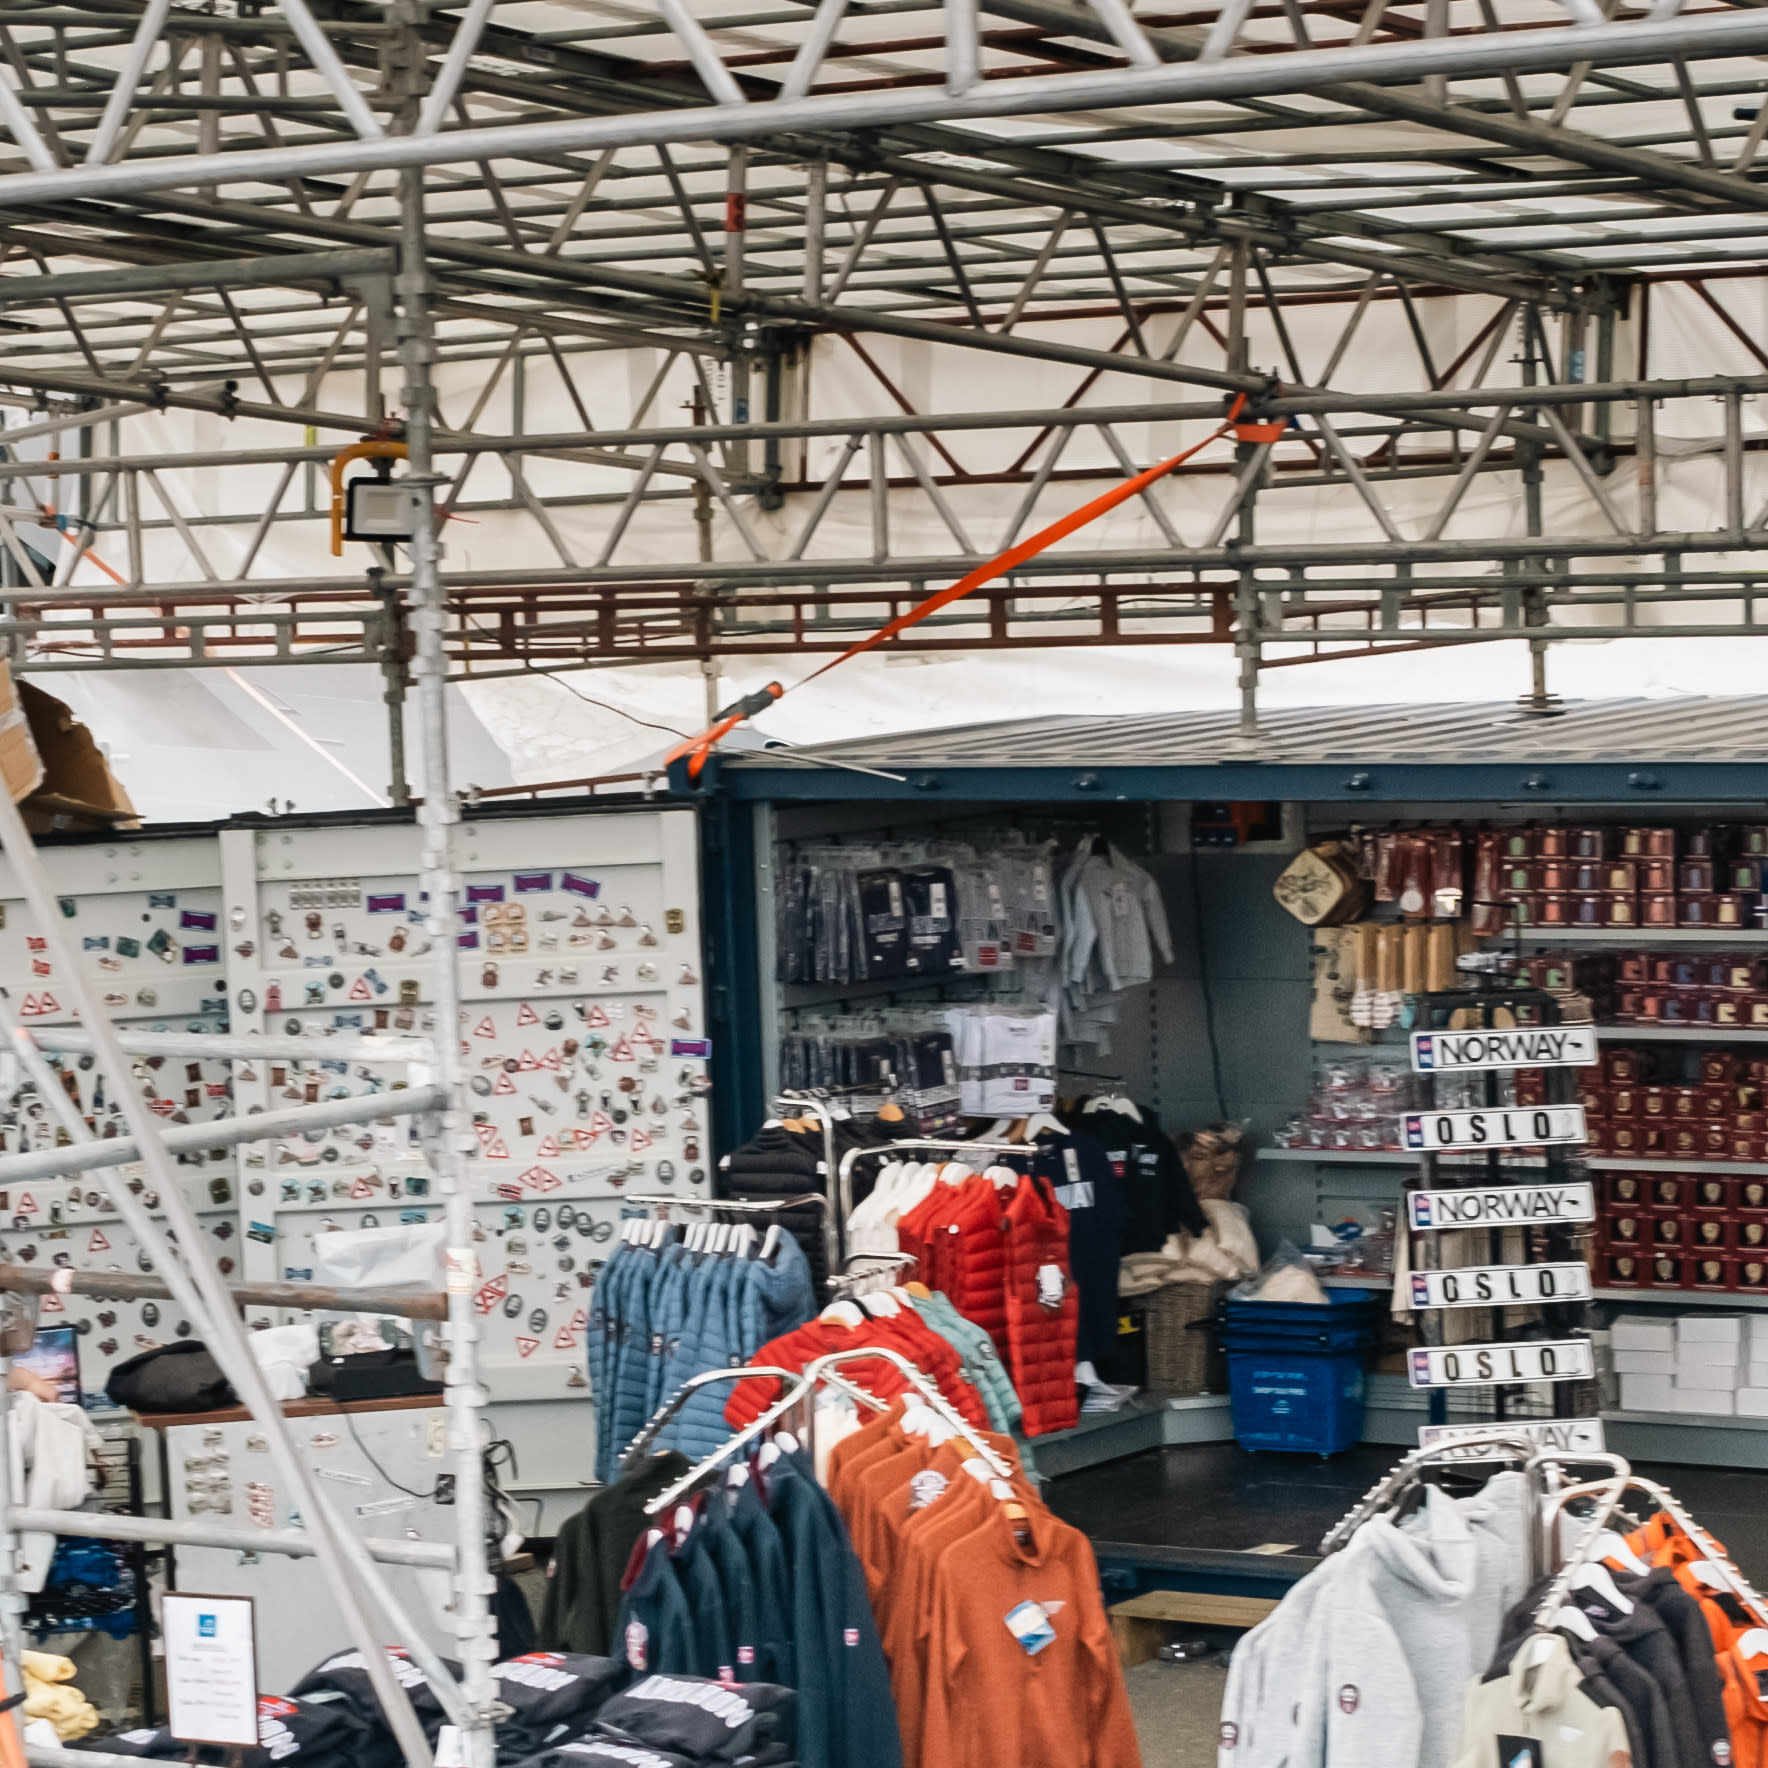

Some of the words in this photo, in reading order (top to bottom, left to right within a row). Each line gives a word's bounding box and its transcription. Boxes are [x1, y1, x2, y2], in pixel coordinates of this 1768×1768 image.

[1440, 1032, 1569, 1066] NORWAY
[1437, 1111, 1551, 1145] OSLO
[1438, 1190, 1565, 1222] NORWAY
[1442, 1269, 1556, 1303] OSLO
[1444, 1347, 1556, 1382] OSLO
